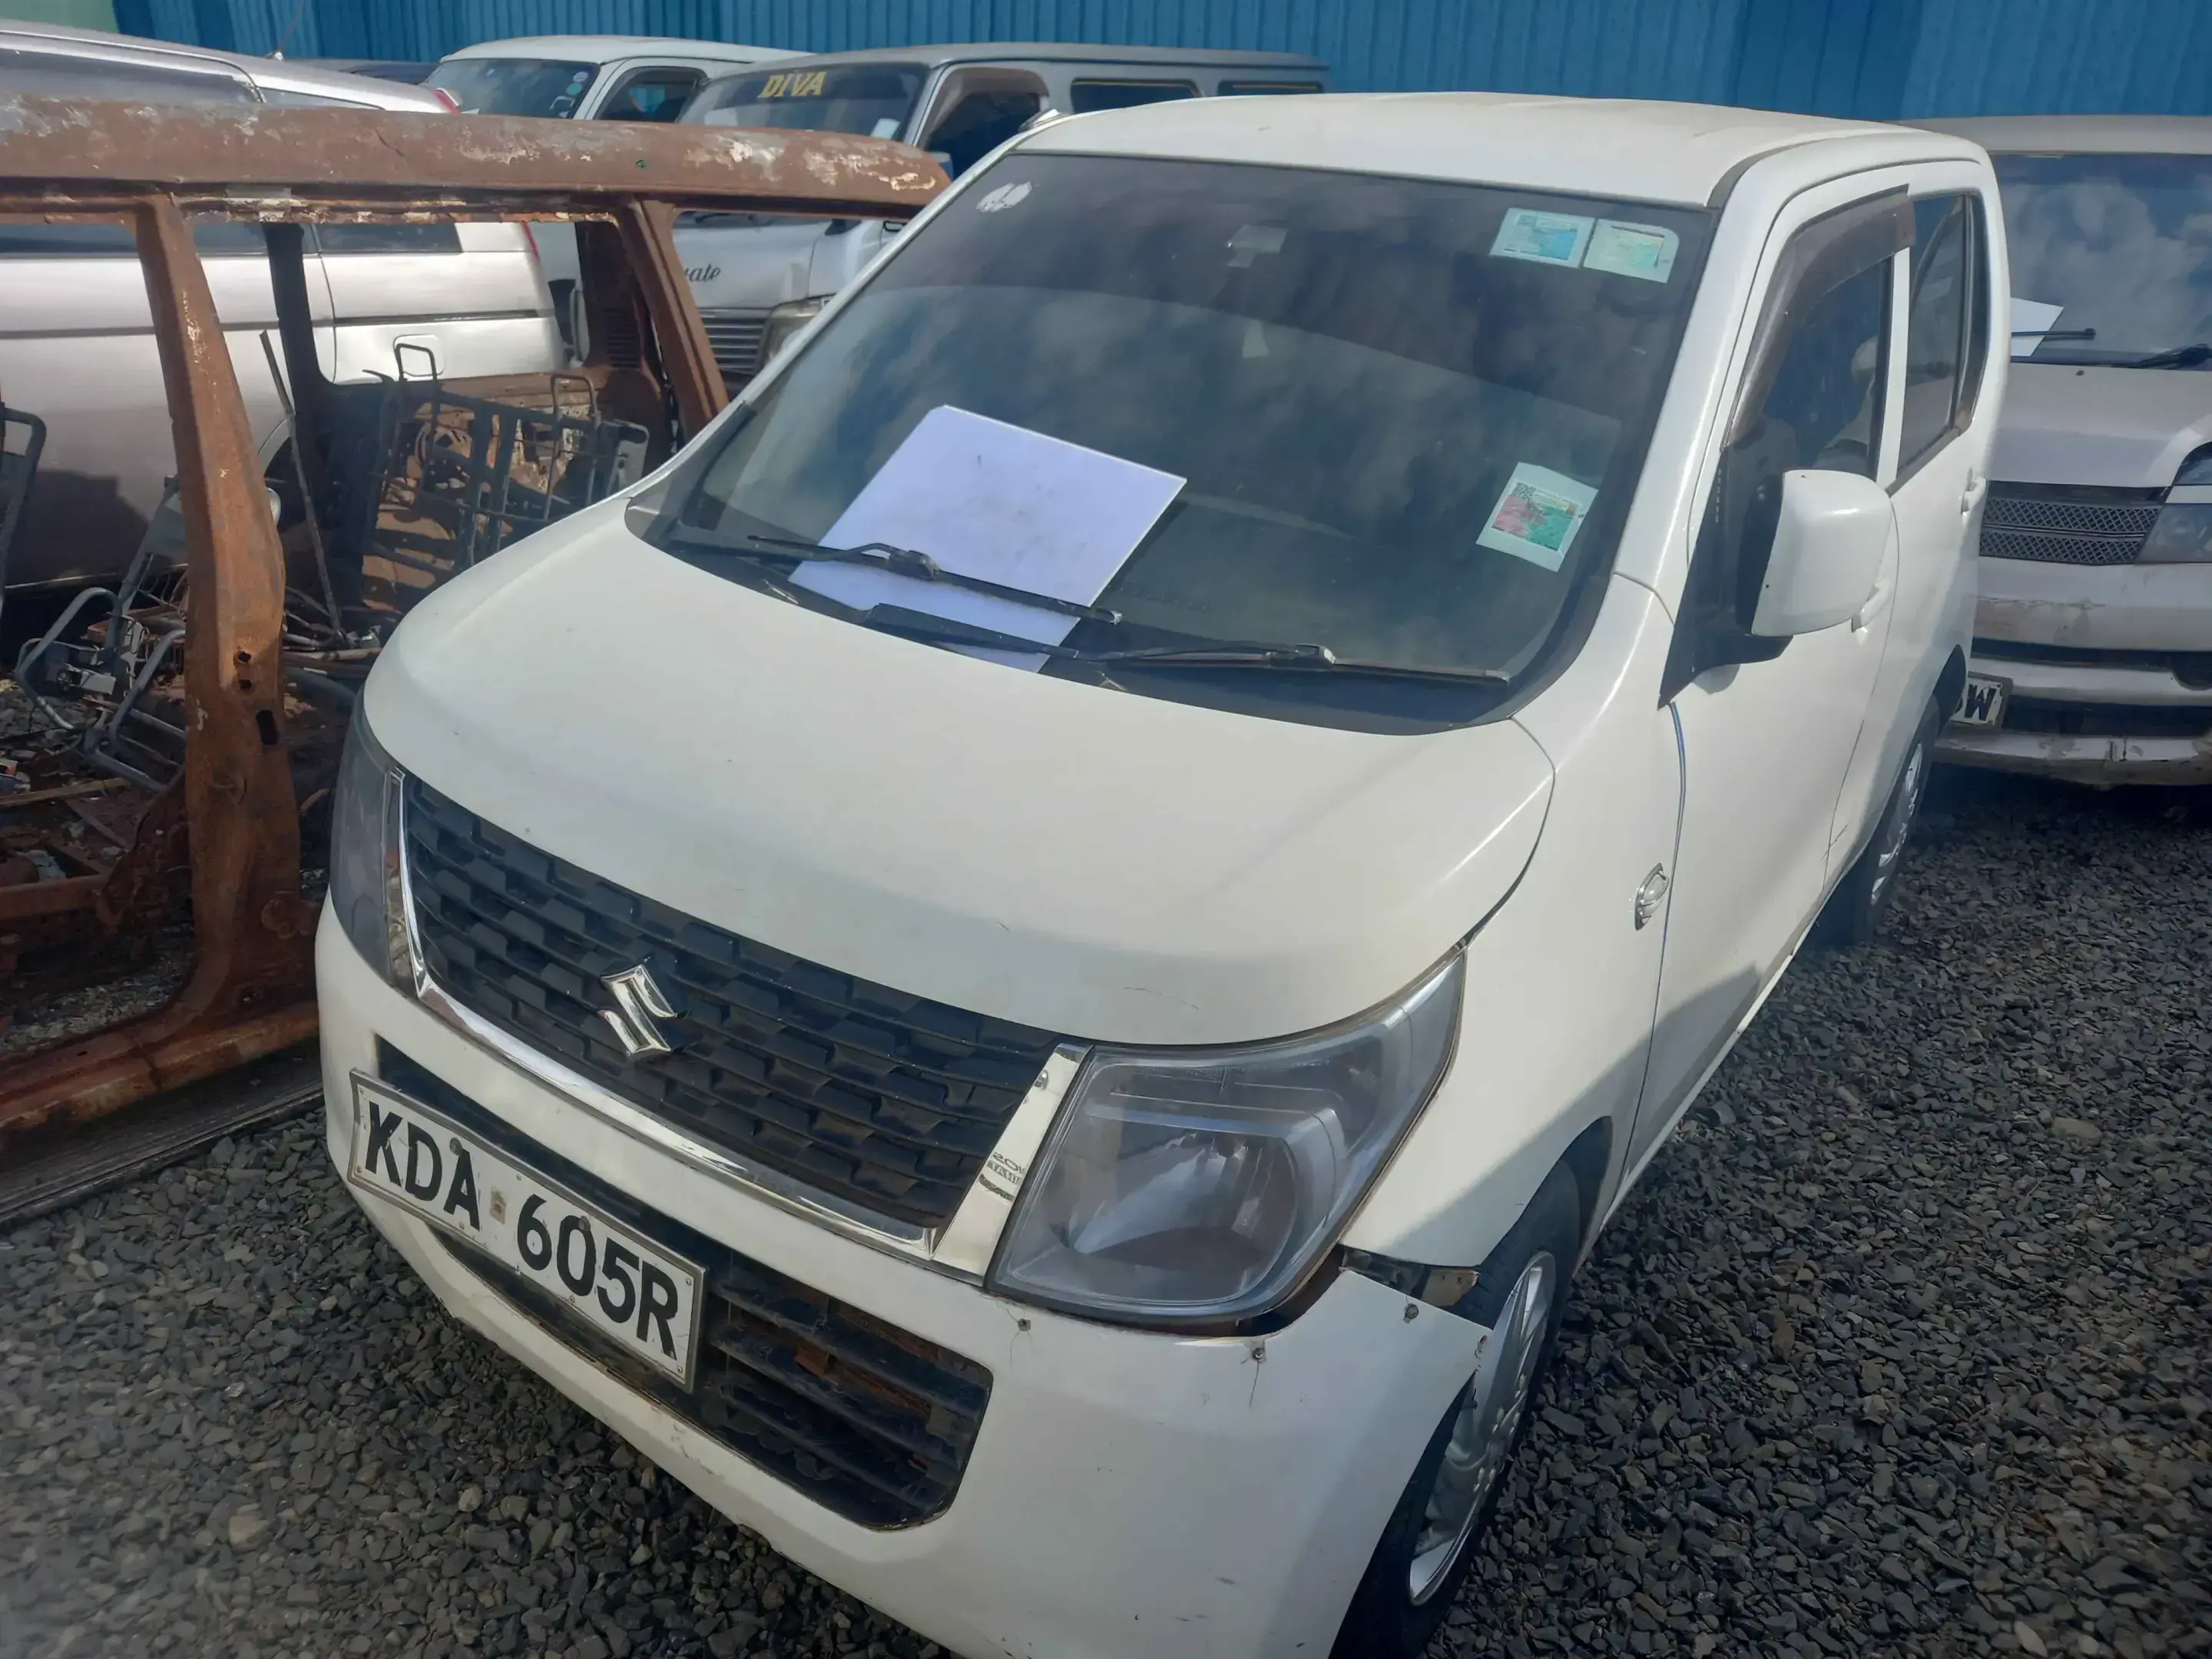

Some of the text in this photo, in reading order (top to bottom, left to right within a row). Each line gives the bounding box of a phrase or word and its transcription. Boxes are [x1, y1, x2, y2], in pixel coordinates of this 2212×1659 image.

[757, 71, 827, 98] DIVA
[1955, 684, 1997, 721] W
[365, 1101, 679, 1360] KDA 605R
